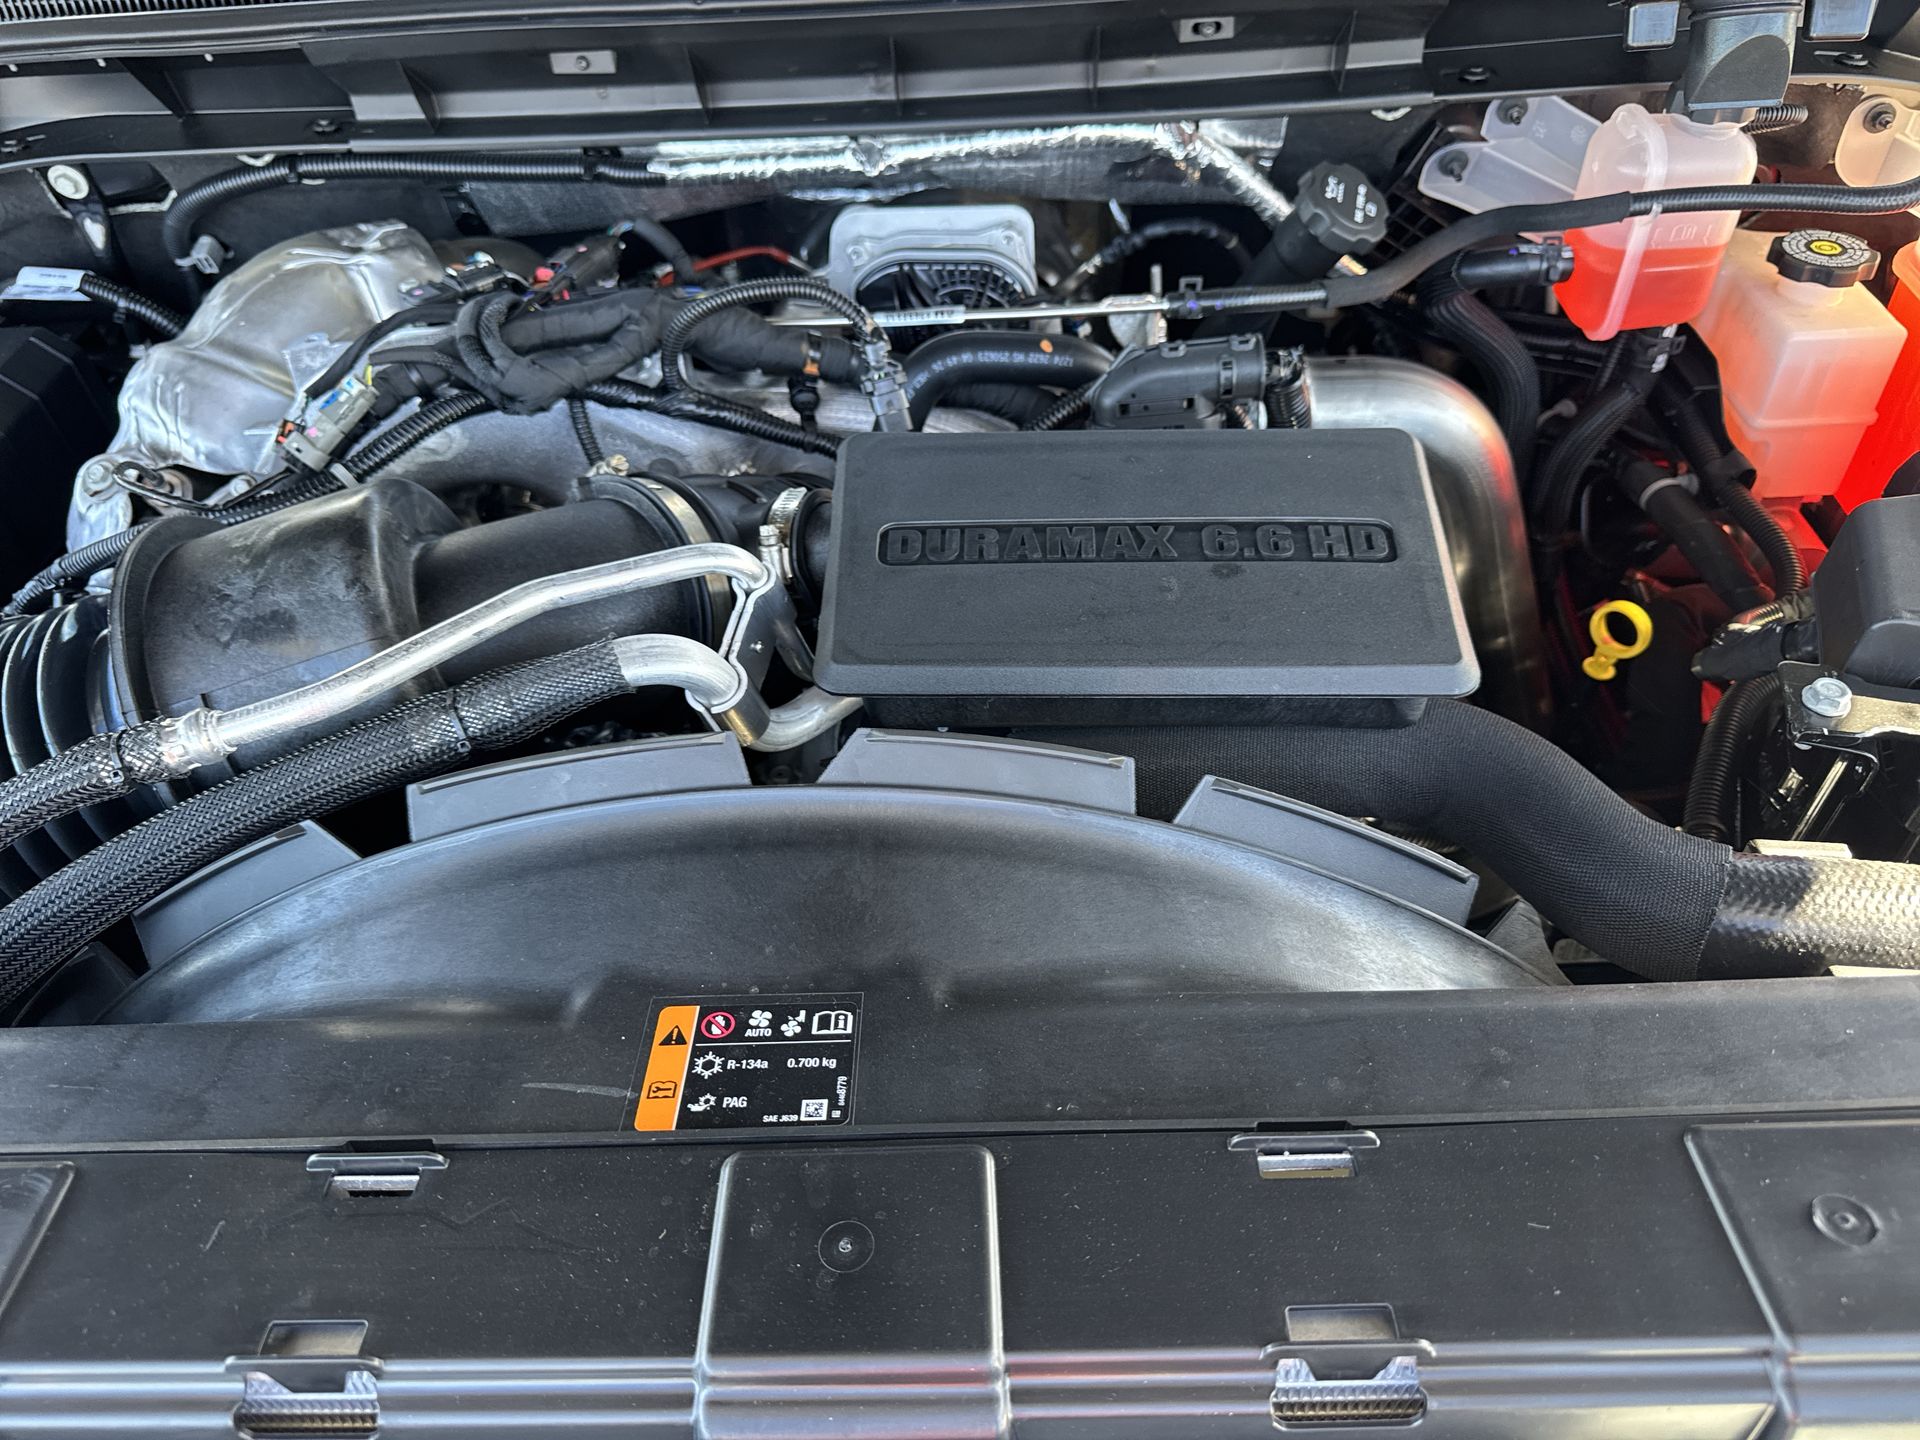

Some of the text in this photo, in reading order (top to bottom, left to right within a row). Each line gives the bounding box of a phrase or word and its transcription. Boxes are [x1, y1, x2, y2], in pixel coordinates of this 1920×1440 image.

[886, 524, 1390, 561] DURAMAX 6.6 HD
[745, 1028, 772, 1037] AUTO
[726, 1057, 837, 1070] R-134a 0.700 kg
[722, 1096, 748, 1108] PAG
[762, 1114, 799, 1123] SAE J639
